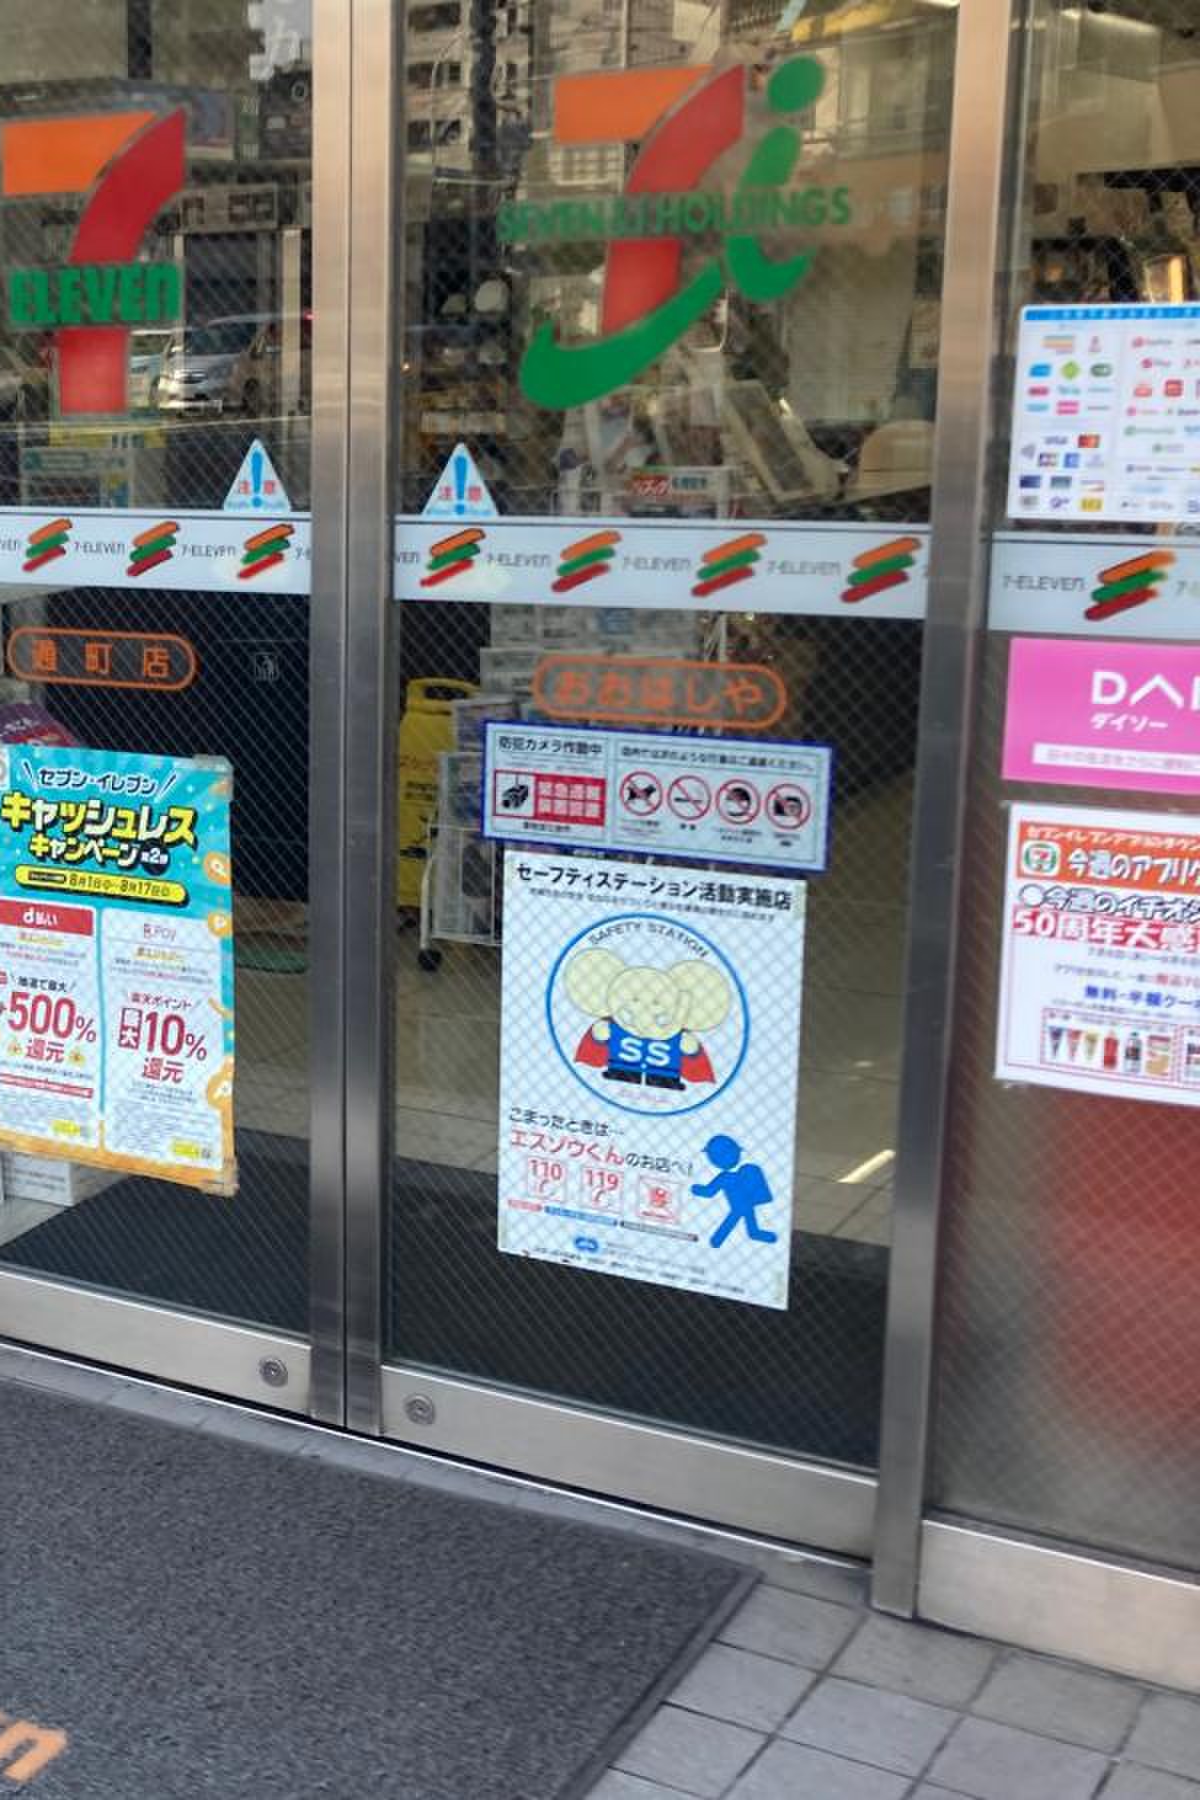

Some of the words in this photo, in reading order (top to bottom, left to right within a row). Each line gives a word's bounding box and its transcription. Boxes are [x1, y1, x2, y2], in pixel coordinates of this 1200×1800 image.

[656, 187, 851, 233] HOLDINGS
[8, 262, 182, 326] ELEVEN
[1001, 572, 1086, 593] 7-ELEVEN
[1090, 712, 1169, 733] ダイソー
[498, 735, 603, 756] 防犯カメラ作動中
[39, 767, 157, 795] セブン・イレブン
[1, 791, 198, 851] キャッシュレス
[29, 832, 141, 868] キャンペーン
[516, 863, 793, 912] セーフティステーション活動実施店
[587, 921, 643, 947] SAFETY
[646, 923, 710, 959] STATION
[530, 1157, 563, 1181] 110
[585, 1169, 619, 1191] 119
